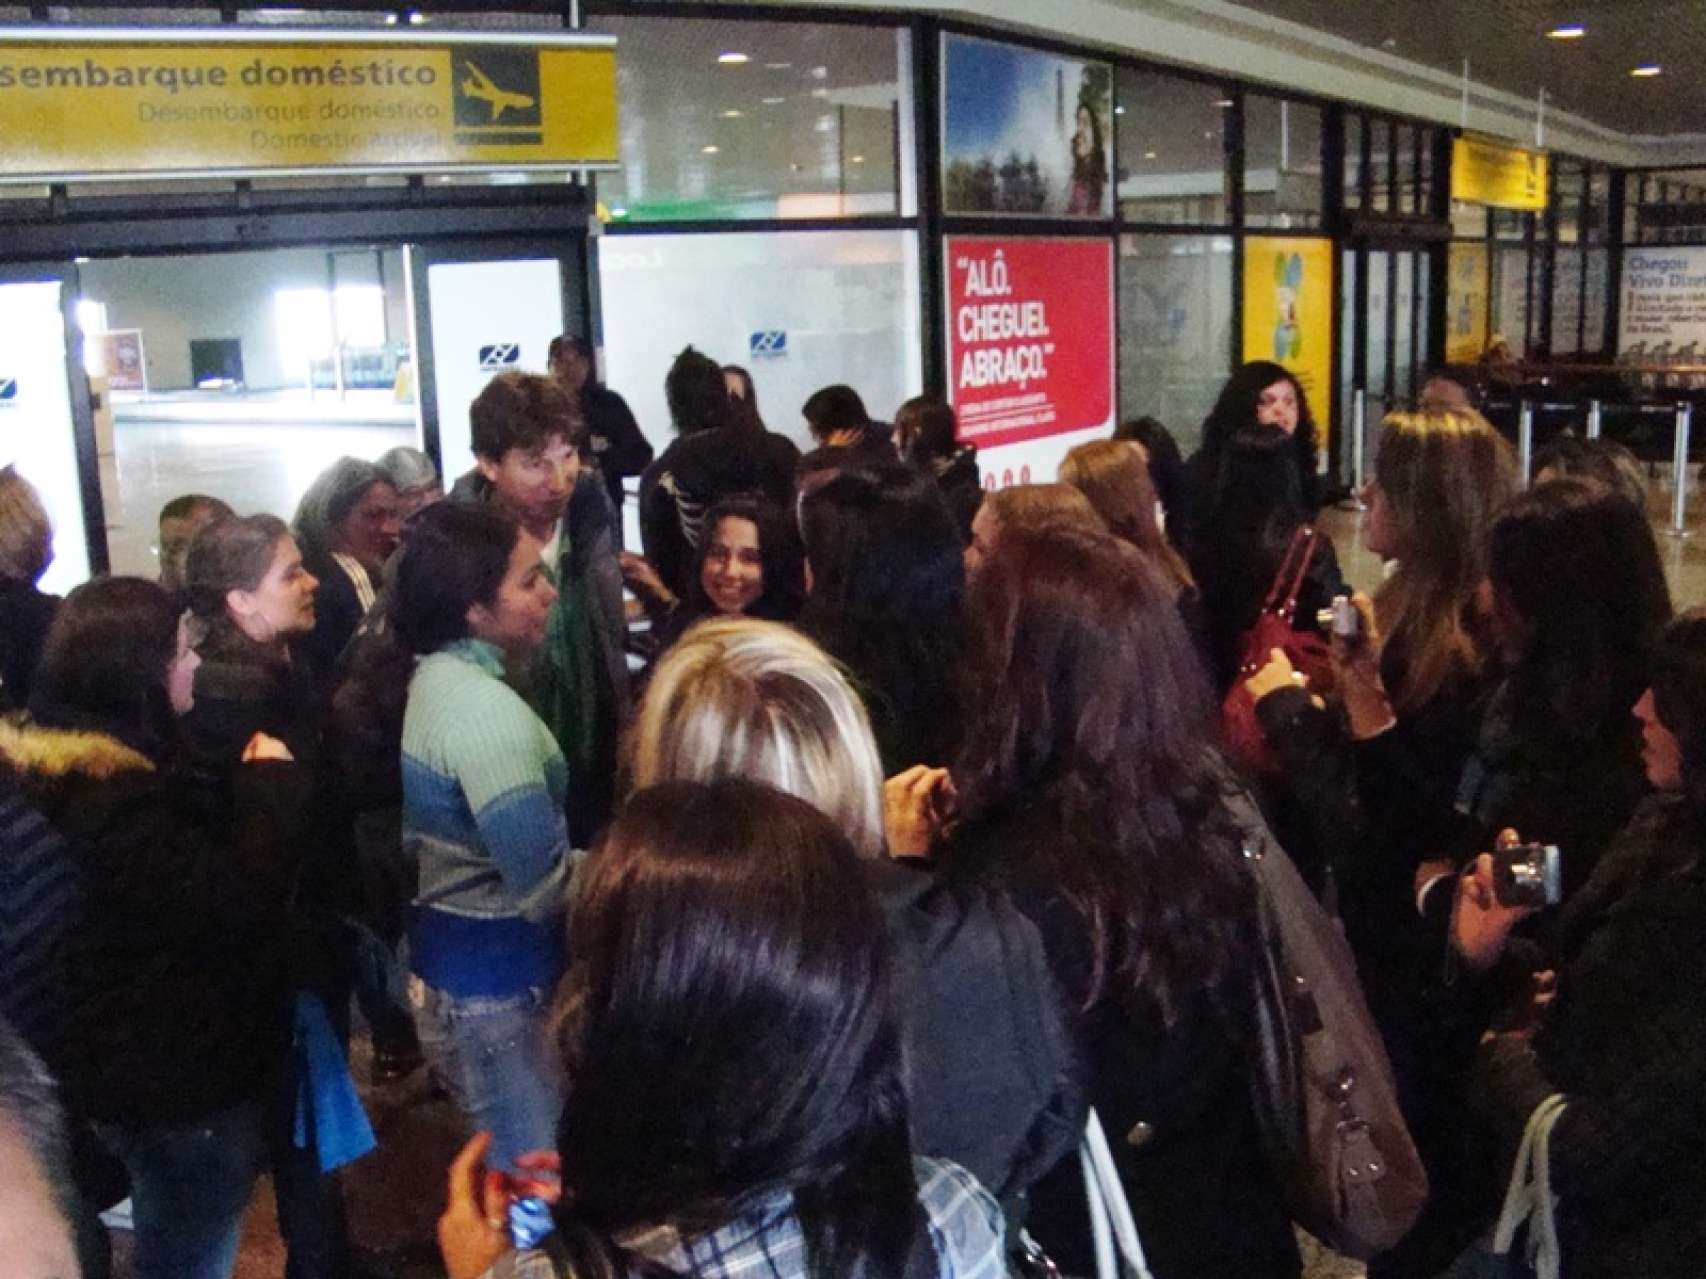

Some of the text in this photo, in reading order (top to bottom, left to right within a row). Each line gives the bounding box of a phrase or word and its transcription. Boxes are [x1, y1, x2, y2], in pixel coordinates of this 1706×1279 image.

[242, 58, 436, 86] doméstico
[138, 99, 440, 125] Desembarque doméstico
[250, 129, 360, 152] Domestic
